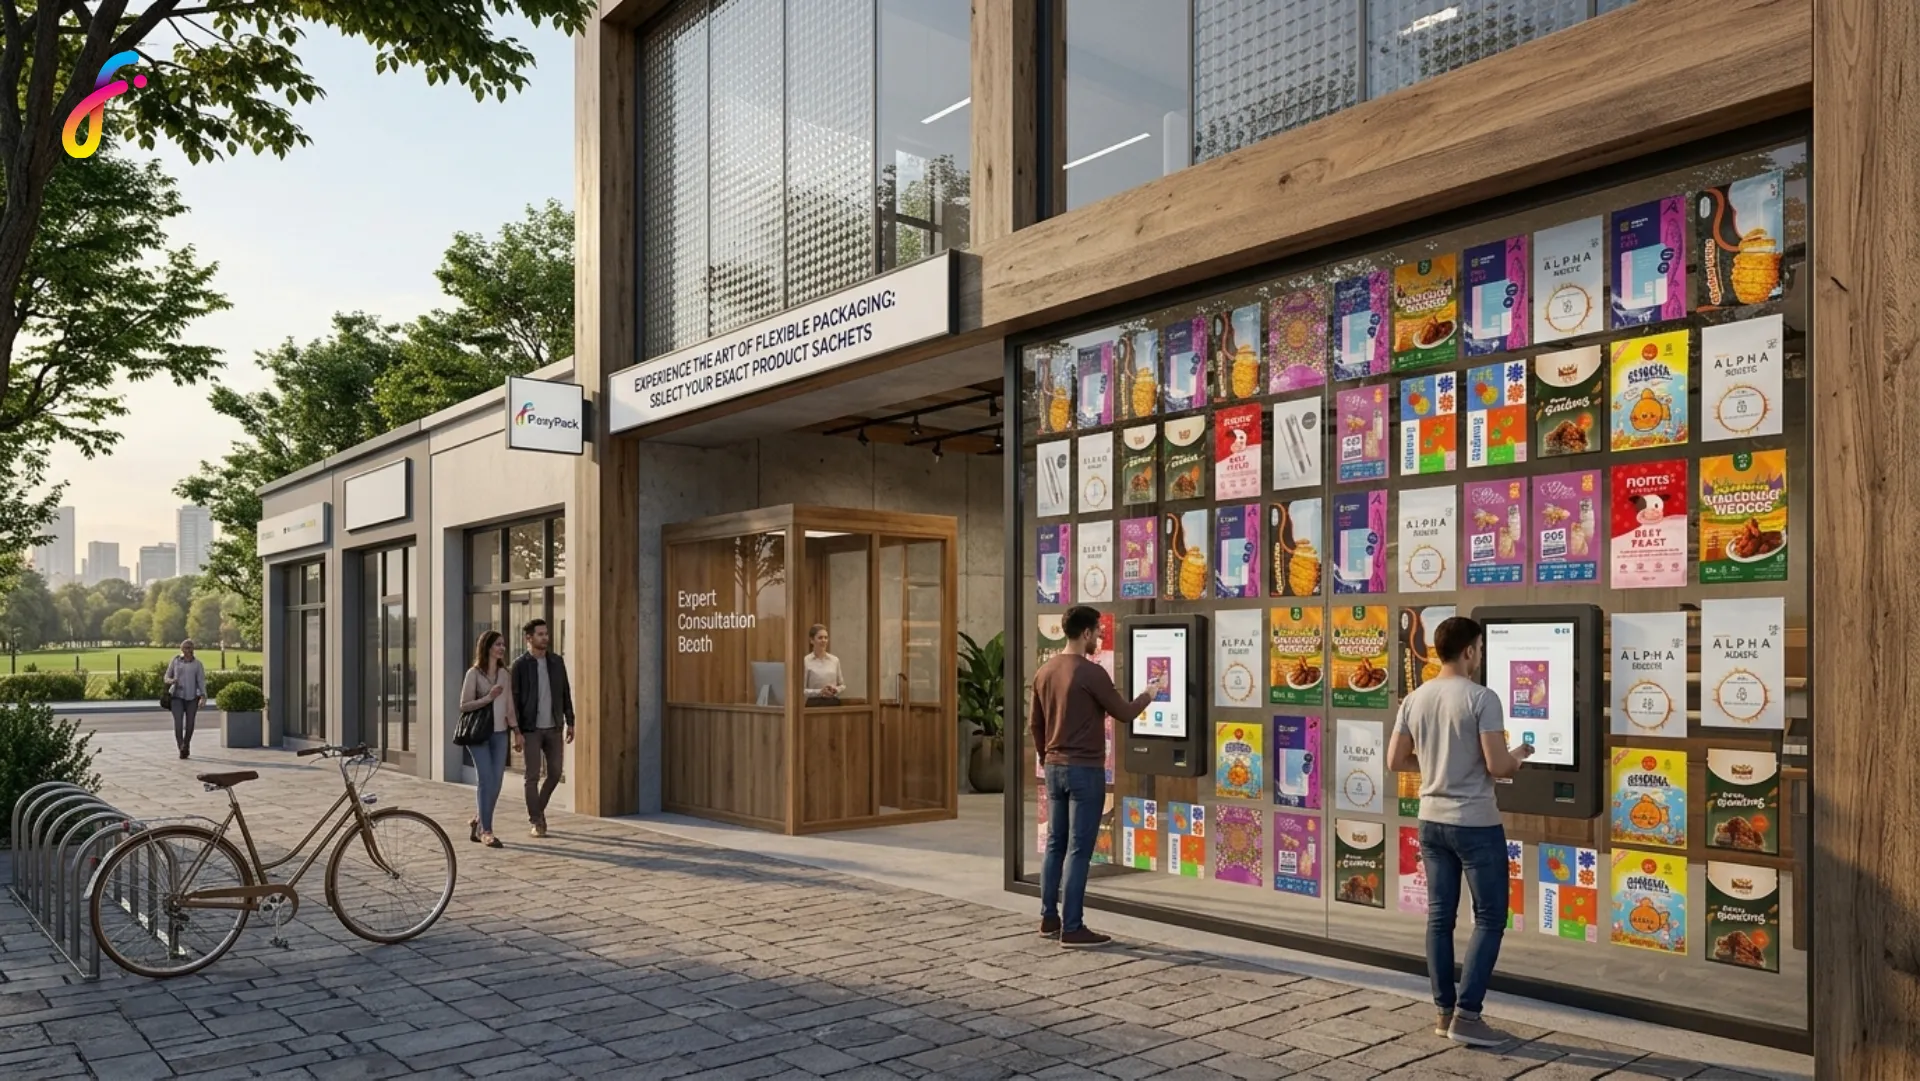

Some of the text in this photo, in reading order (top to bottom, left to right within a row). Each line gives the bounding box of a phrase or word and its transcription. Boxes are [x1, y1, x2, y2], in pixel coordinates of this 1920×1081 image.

[634, 290, 896, 393] EXPERIENCE THE ART OF FLEXIBLE PACKAGING:
[685, 375, 713, 397] YOUR
[752, 342, 809, 376] PRODUCT
[812, 322, 873, 357] SACHETS
[1714, 352, 1769, 369] ALPHA
[678, 589, 717, 611] Expert
[677, 612, 756, 630] Consultation
[1713, 638, 1771, 649] ALPHA
[1620, 650, 1674, 661] ALPHA
